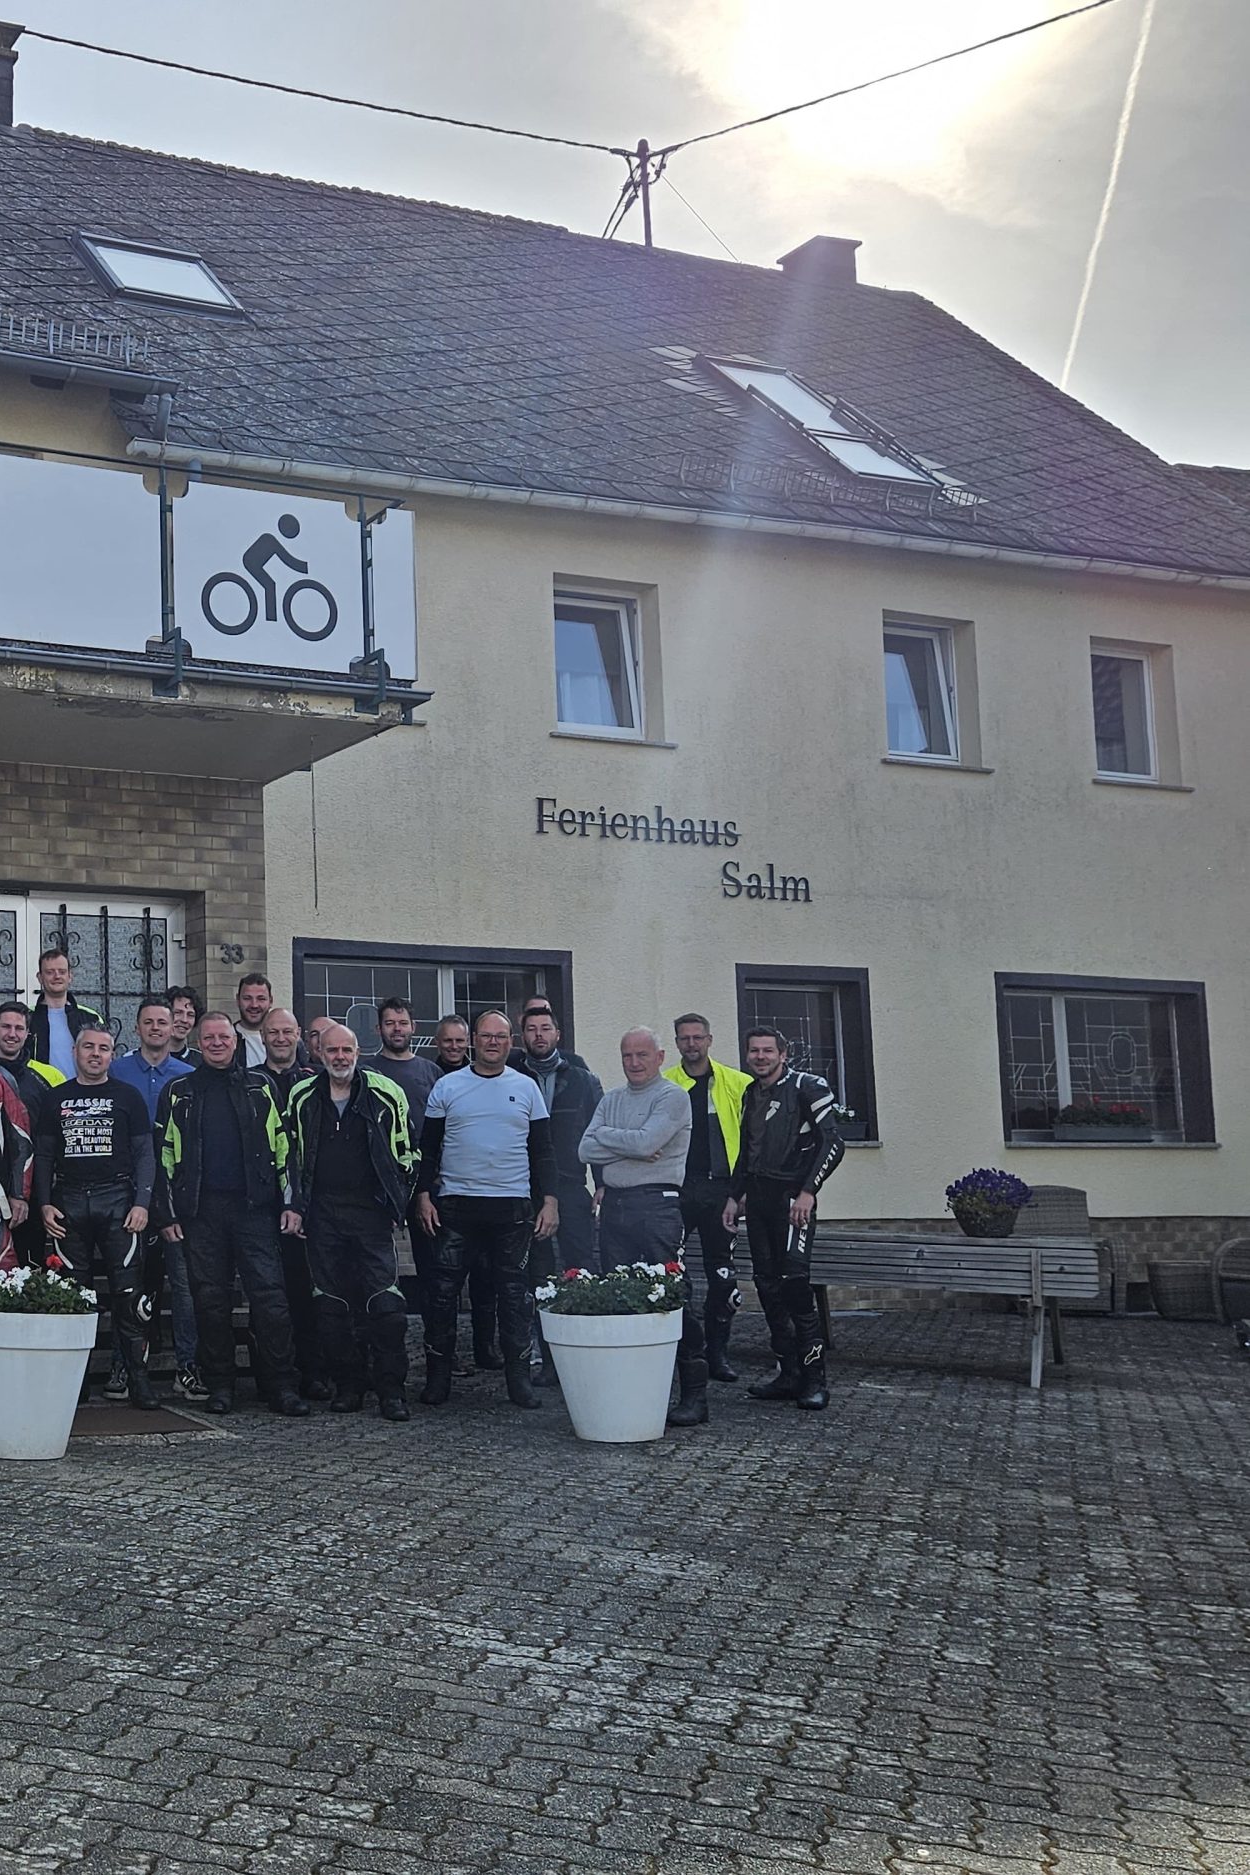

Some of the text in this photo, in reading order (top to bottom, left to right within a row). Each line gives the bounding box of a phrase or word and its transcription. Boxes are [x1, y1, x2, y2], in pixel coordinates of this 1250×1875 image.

[535, 797, 742, 847] Ferienhaus
[721, 860, 813, 902] Salm
[220, 943, 244, 964] 33
[61, 1098, 114, 1108] CLASSIC
[61, 1119, 114, 1128] LEGENDARY
[84, 1128, 113, 1136] THE MOST
